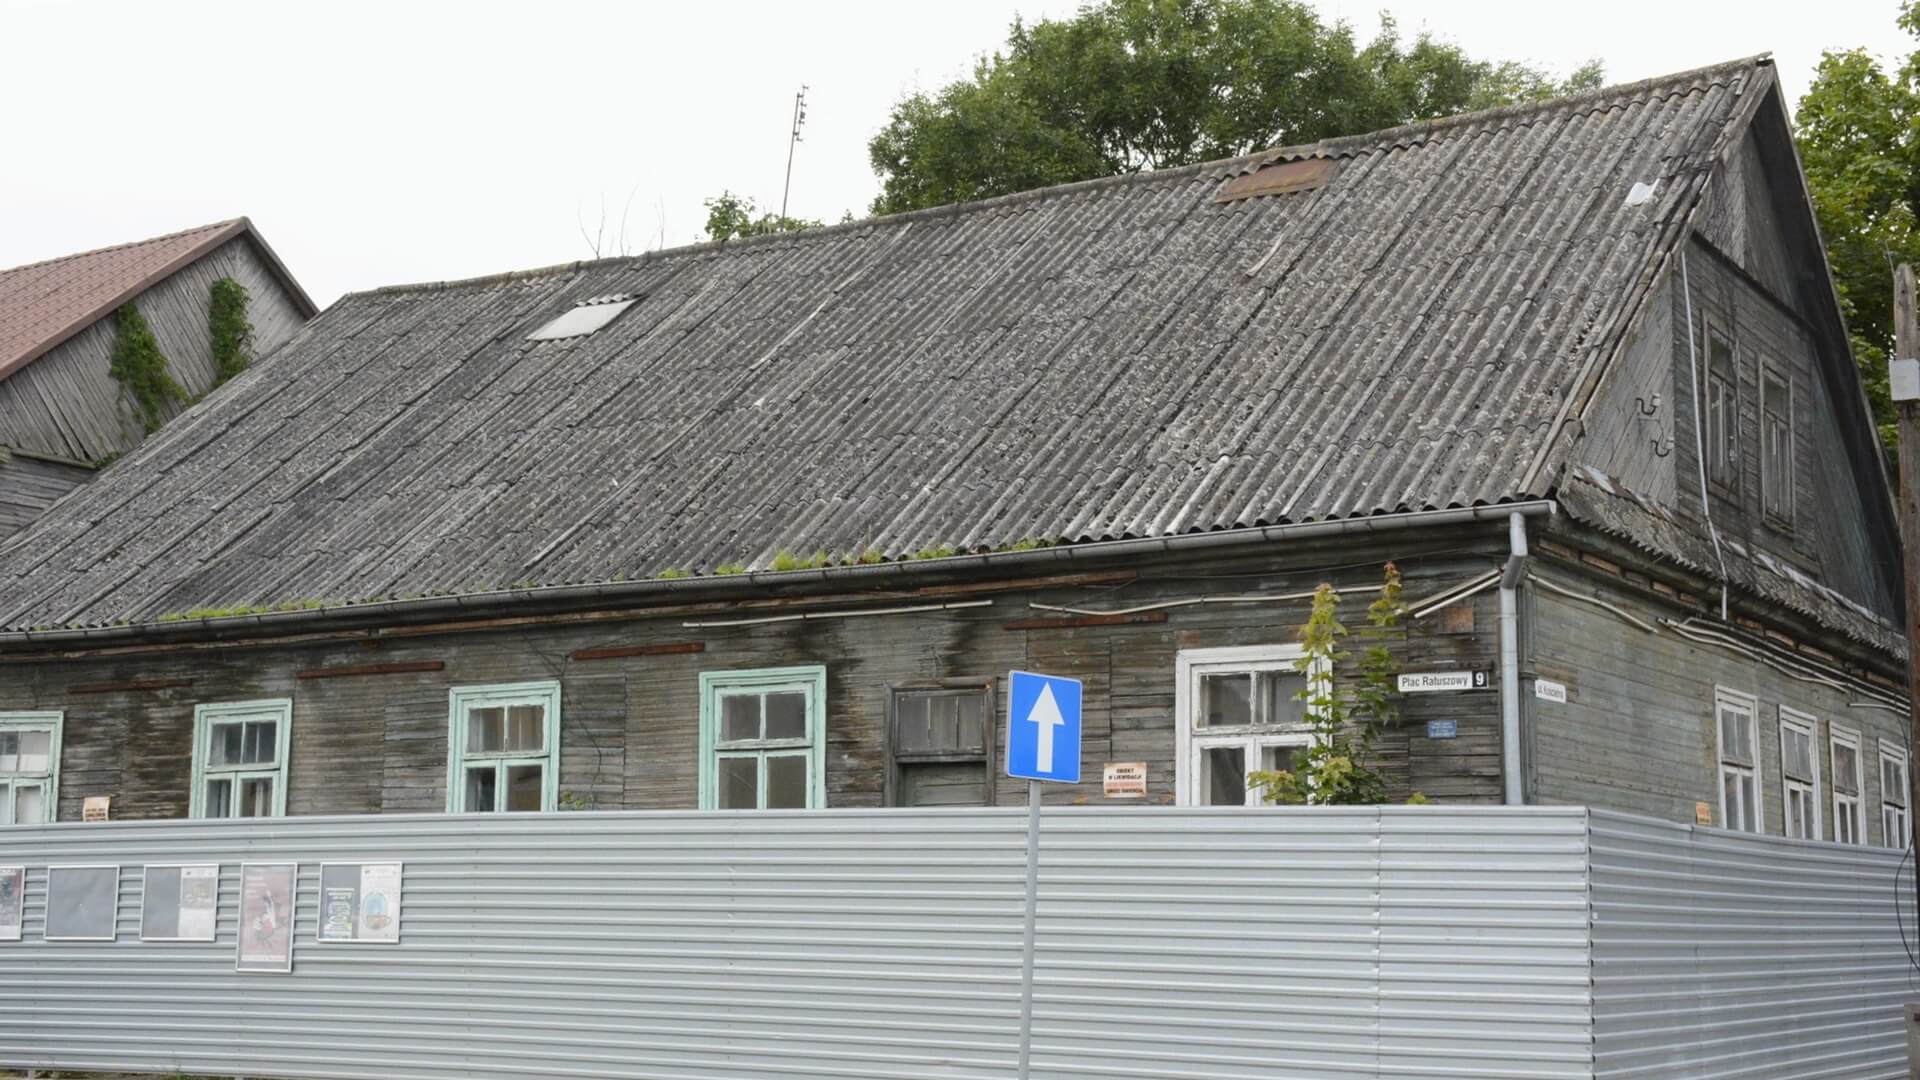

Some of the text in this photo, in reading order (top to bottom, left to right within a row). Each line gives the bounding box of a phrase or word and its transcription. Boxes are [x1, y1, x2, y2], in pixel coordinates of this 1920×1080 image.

[1401, 672, 1484, 687] Plac Ratuszowy 9
